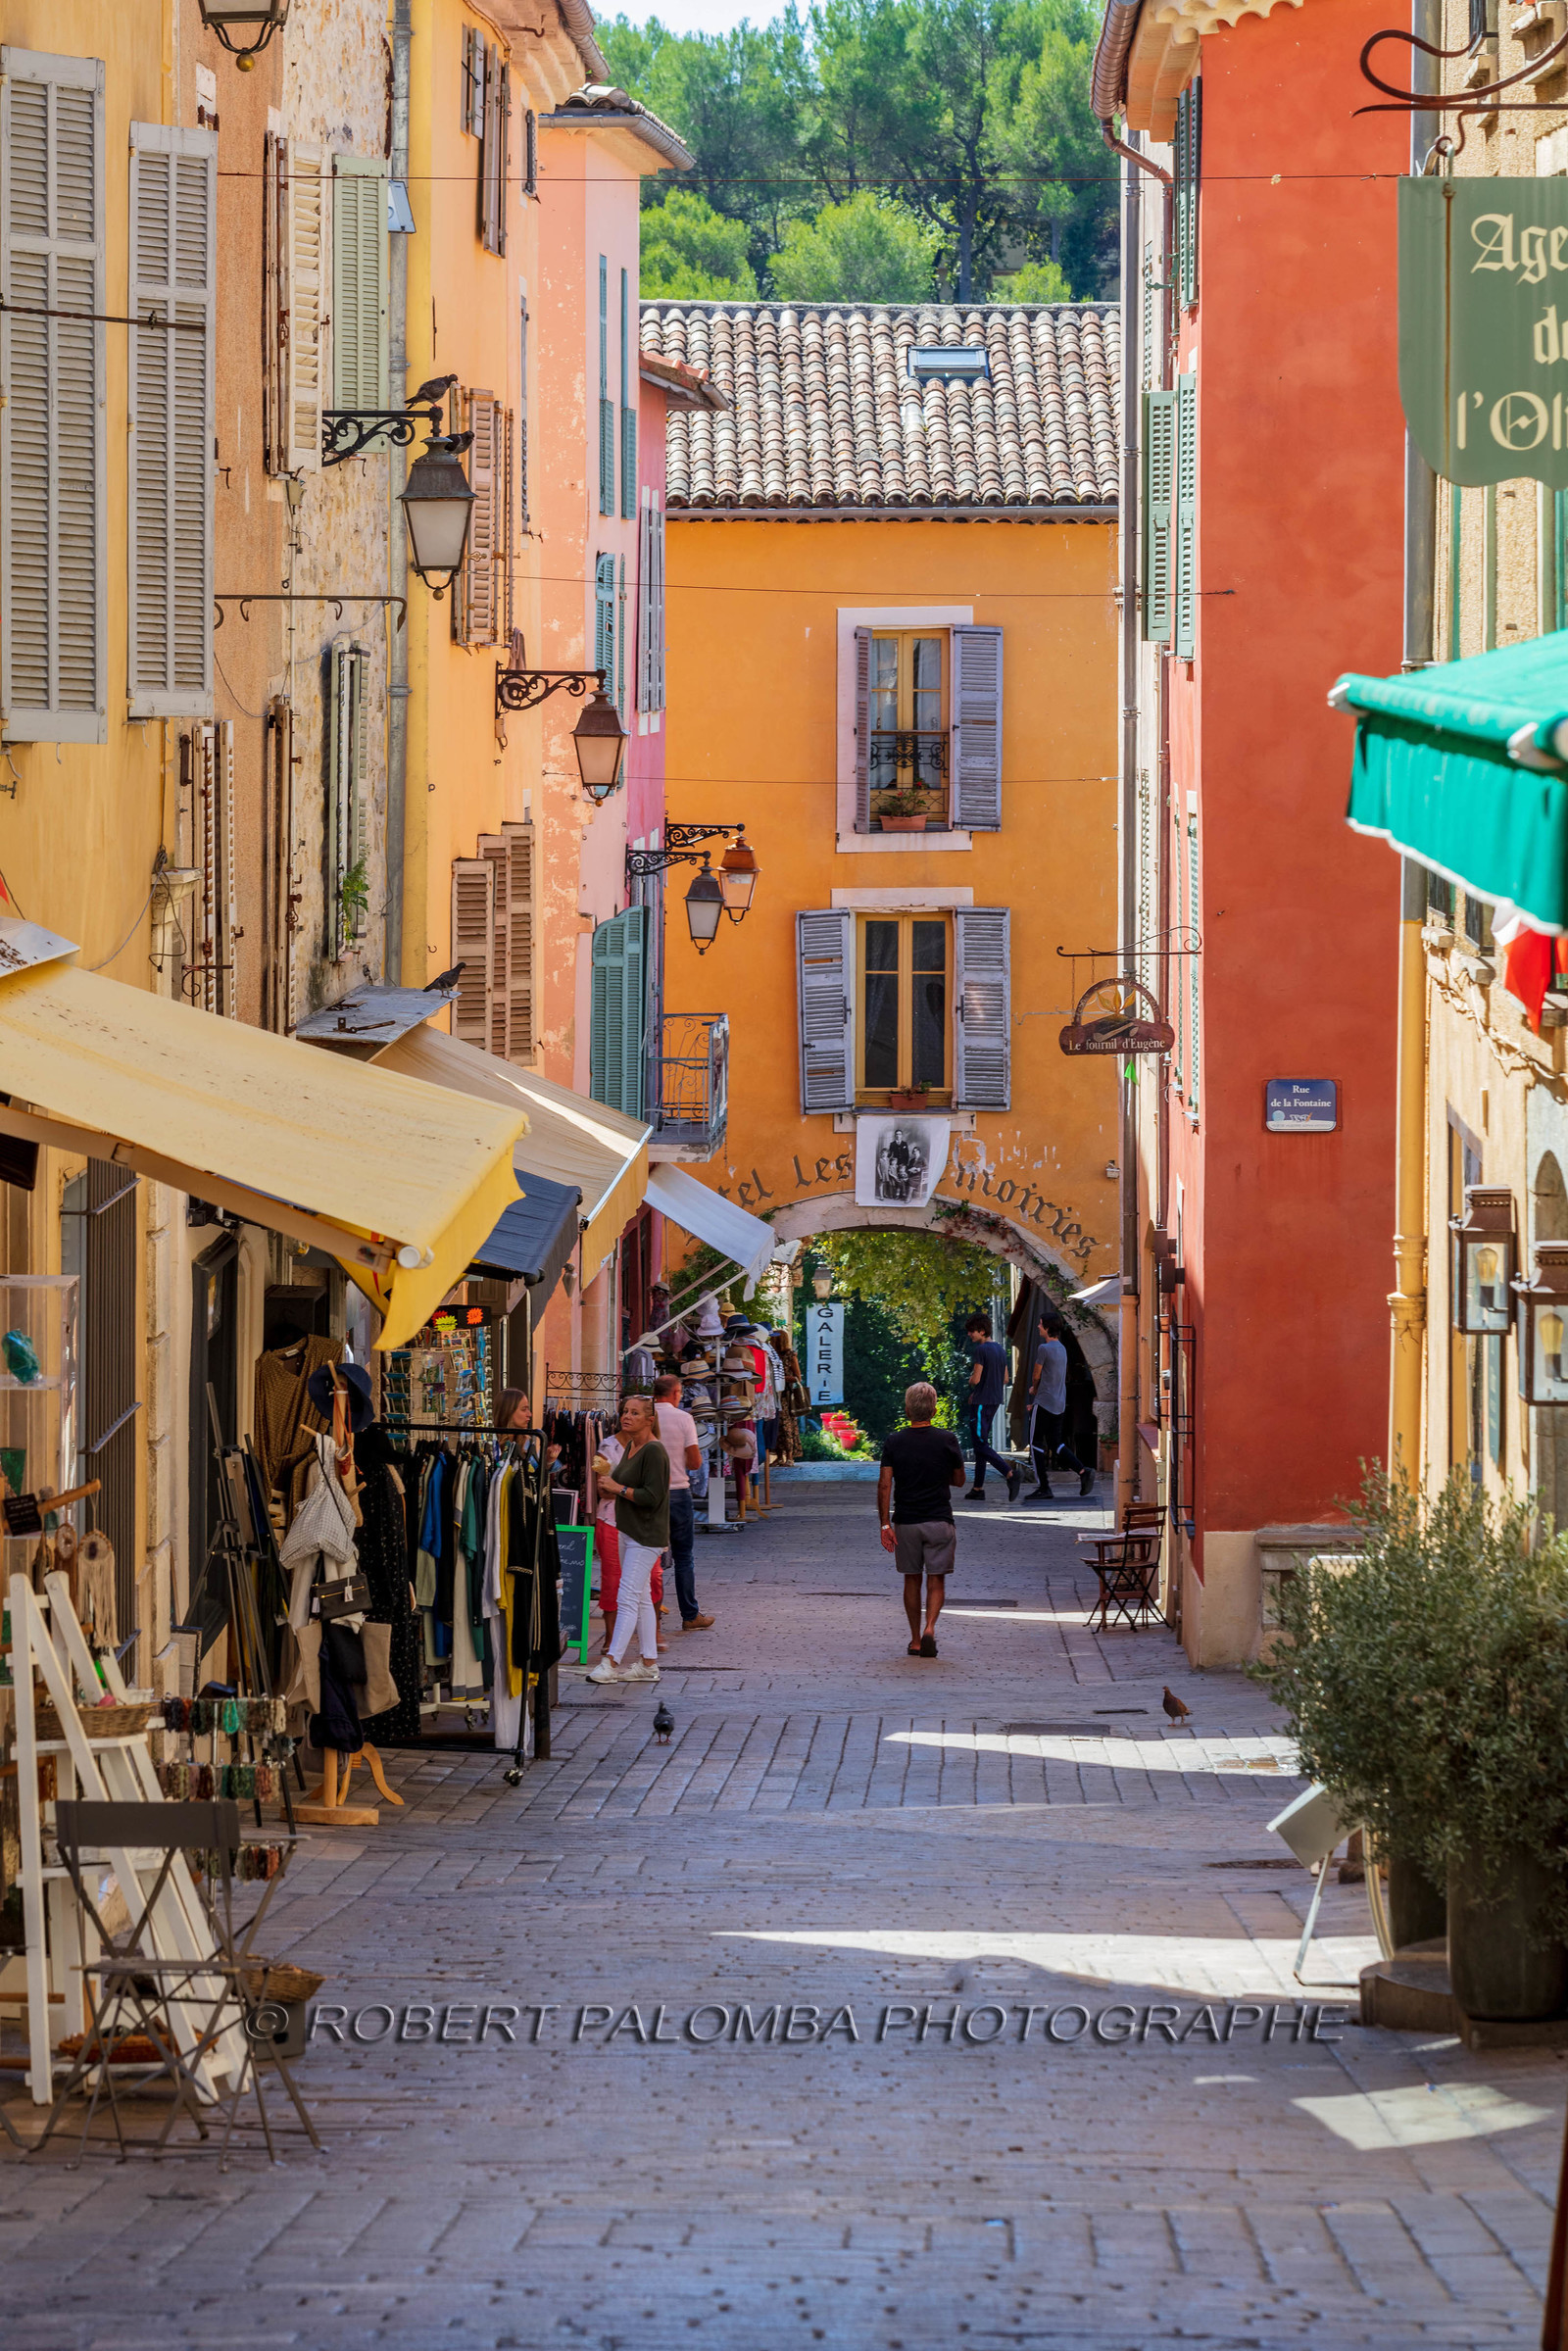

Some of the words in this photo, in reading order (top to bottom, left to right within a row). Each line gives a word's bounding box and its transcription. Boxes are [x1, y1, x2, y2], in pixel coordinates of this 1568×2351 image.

[1533, 304, 1568, 366] d
[1068, 1040, 1081, 1051] Le
[1086, 1039, 1117, 1051] fournil
[1122, 1038, 1166, 1053] d'Eugène
[1292, 1084, 1310, 1094] Rue
[1270, 1098, 1282, 1107] de
[1283, 1098, 1292, 1107] la
[1294, 1098, 1332, 1107] Fontaine
[816, 1307, 834, 1401] GALERIE
